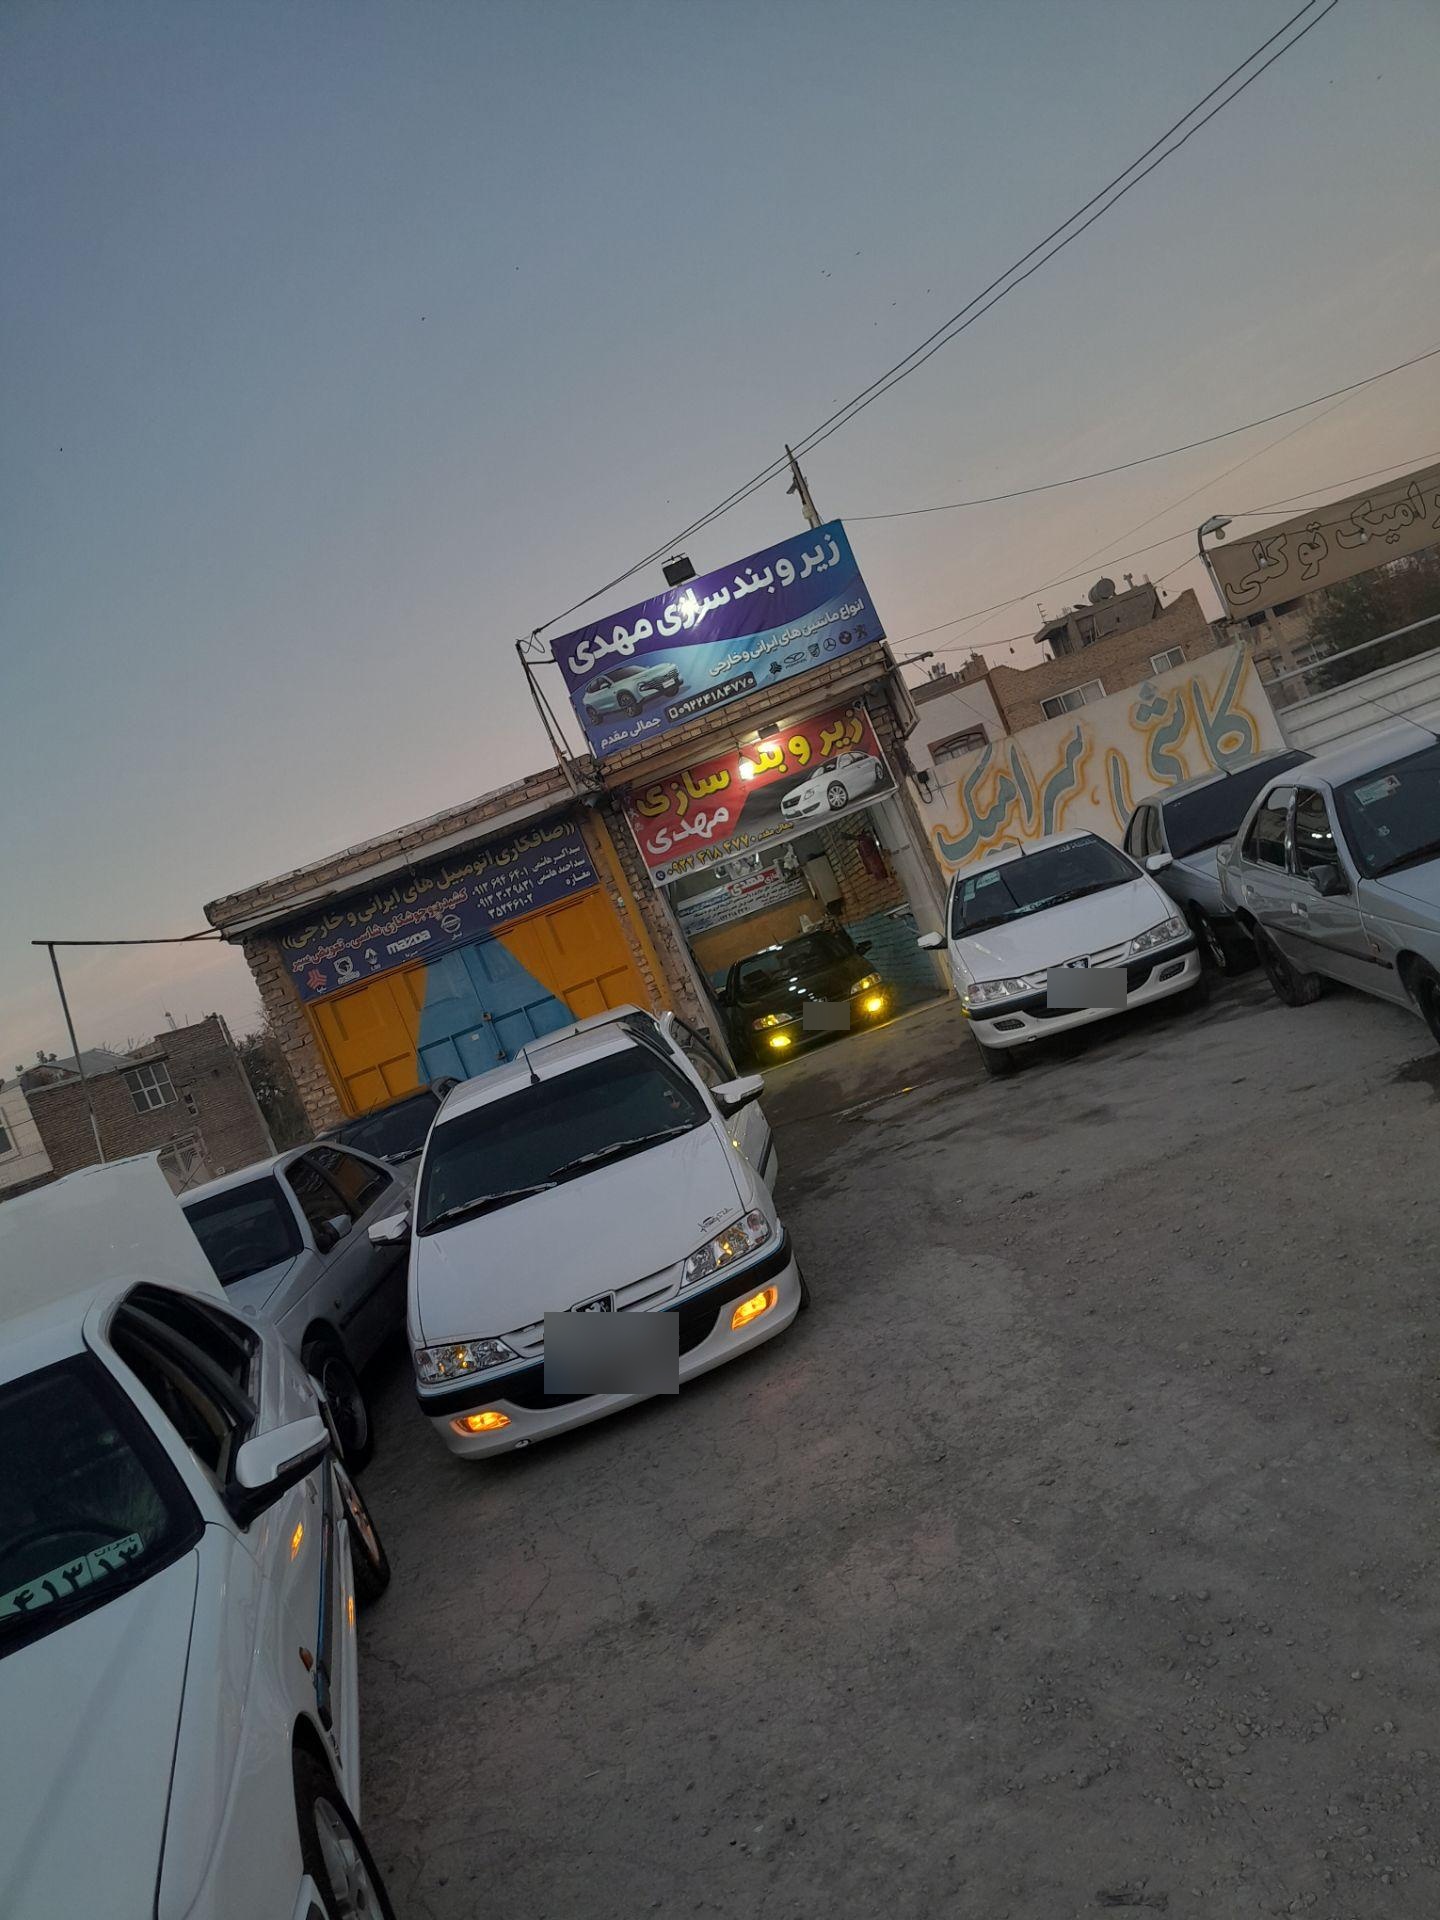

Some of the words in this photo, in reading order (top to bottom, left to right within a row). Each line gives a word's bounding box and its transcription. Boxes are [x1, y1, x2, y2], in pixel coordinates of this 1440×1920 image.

[799, 533, 841, 580] زیر
[1225, 521, 1328, 606] توکلی
[732, 566, 776, 598] بند
[776, 557, 796, 587] و
[655, 586, 731, 638] سازی
[802, 610, 840, 638] ماشین
[840, 597, 865, 622] انواع
[567, 617, 655, 675] مهدی
[750, 635, 779, 661] ایرانی
[778, 624, 802, 645] های
[708, 651, 743, 677] خارجی
[741, 650, 751, 665] و
[600, 728, 629, 750] مقدم
[630, 715, 662, 736] جمالی
[819, 709, 865, 756] زیر
[789, 734, 811, 765] و
[637, 768, 731, 816] سازی
[646, 806, 729, 855] مهدی
[402, 869, 435, 904] های
[436, 849, 494, 895] اتومبیل
[730, 873, 765, 897] مهدی
[346, 912, 358, 927] و
[358, 887, 401, 923] ایرانی
[386, 929, 432, 955] mazda
